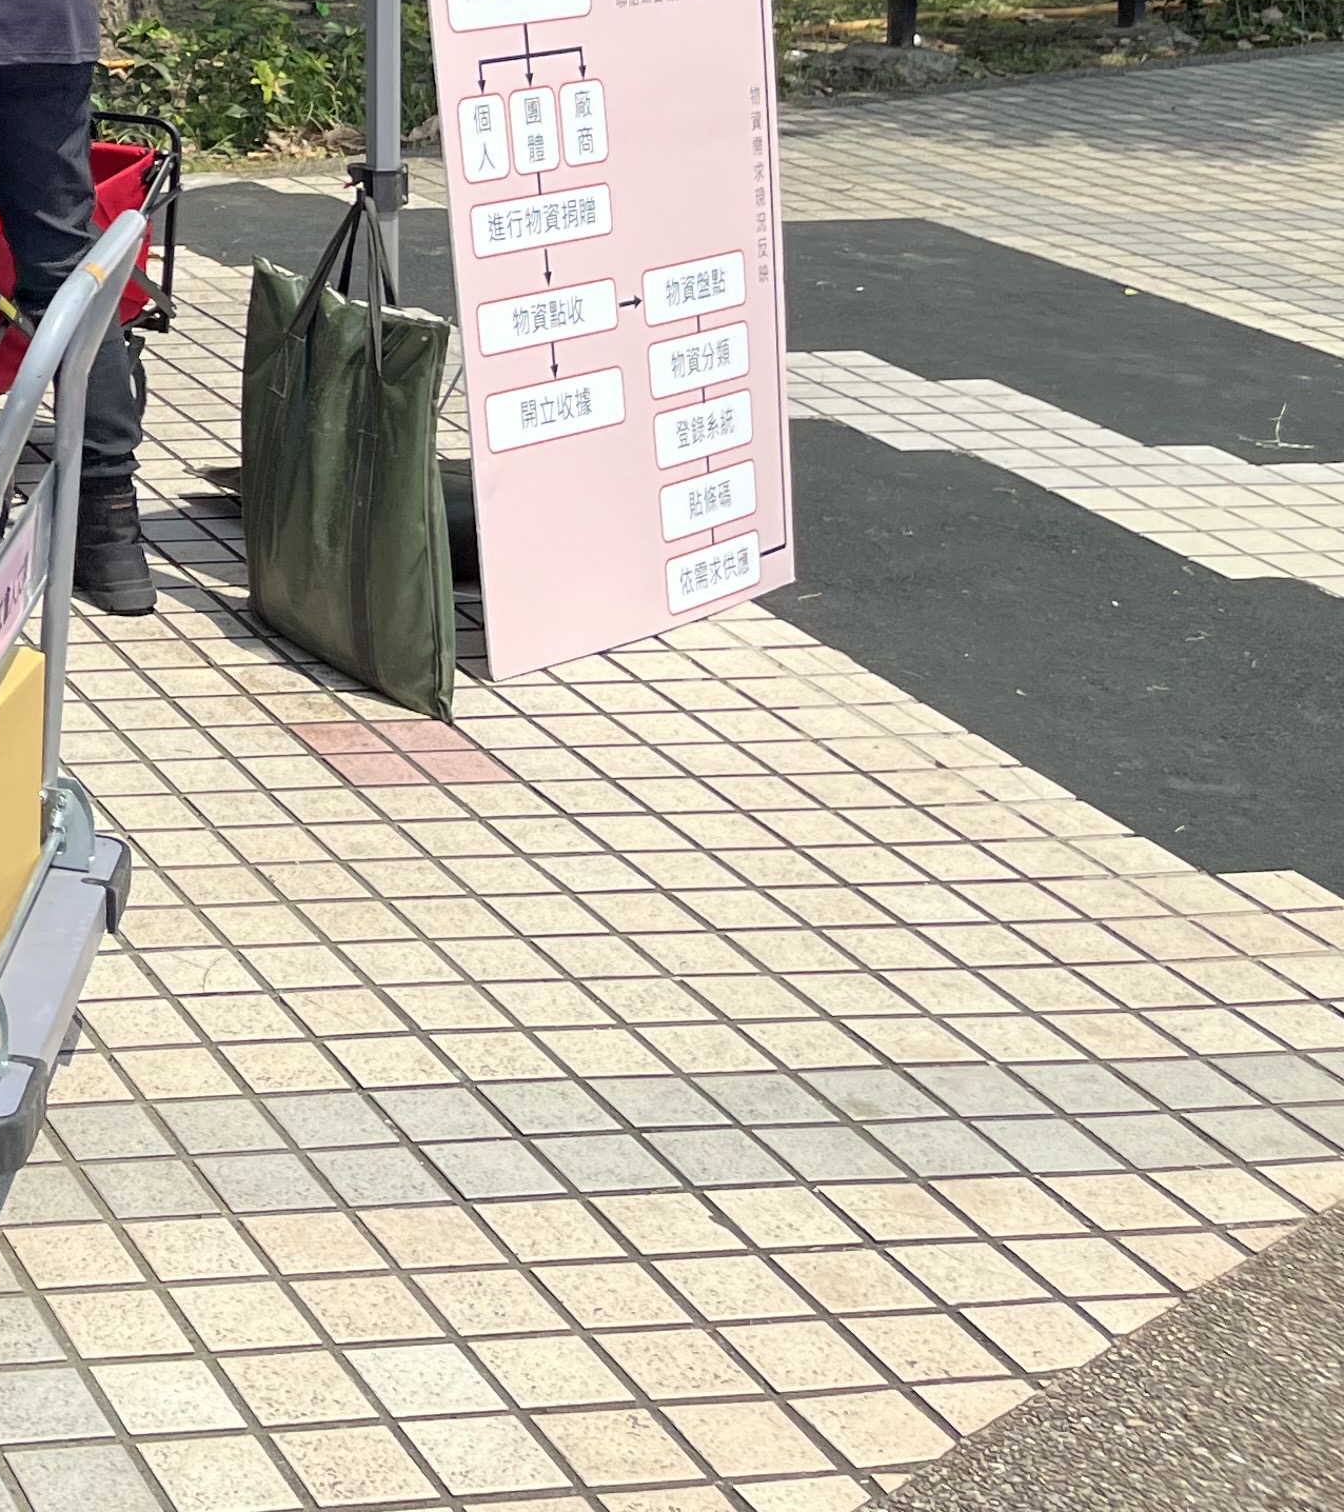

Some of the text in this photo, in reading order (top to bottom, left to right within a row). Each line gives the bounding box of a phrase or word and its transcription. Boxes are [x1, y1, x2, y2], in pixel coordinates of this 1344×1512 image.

[473, 103, 496, 172] 個人
[524, 96, 546, 164] 團體
[574, 89, 594, 156] 廠商
[487, 196, 597, 243] 進行物資捐贈
[665, 266, 727, 307] 物資盤點
[512, 295, 586, 337] 物資點收
[670, 337, 732, 380] 物資分類
[520, 386, 593, 431] 開立收據
[679, 547, 750, 596] 依需求供應
